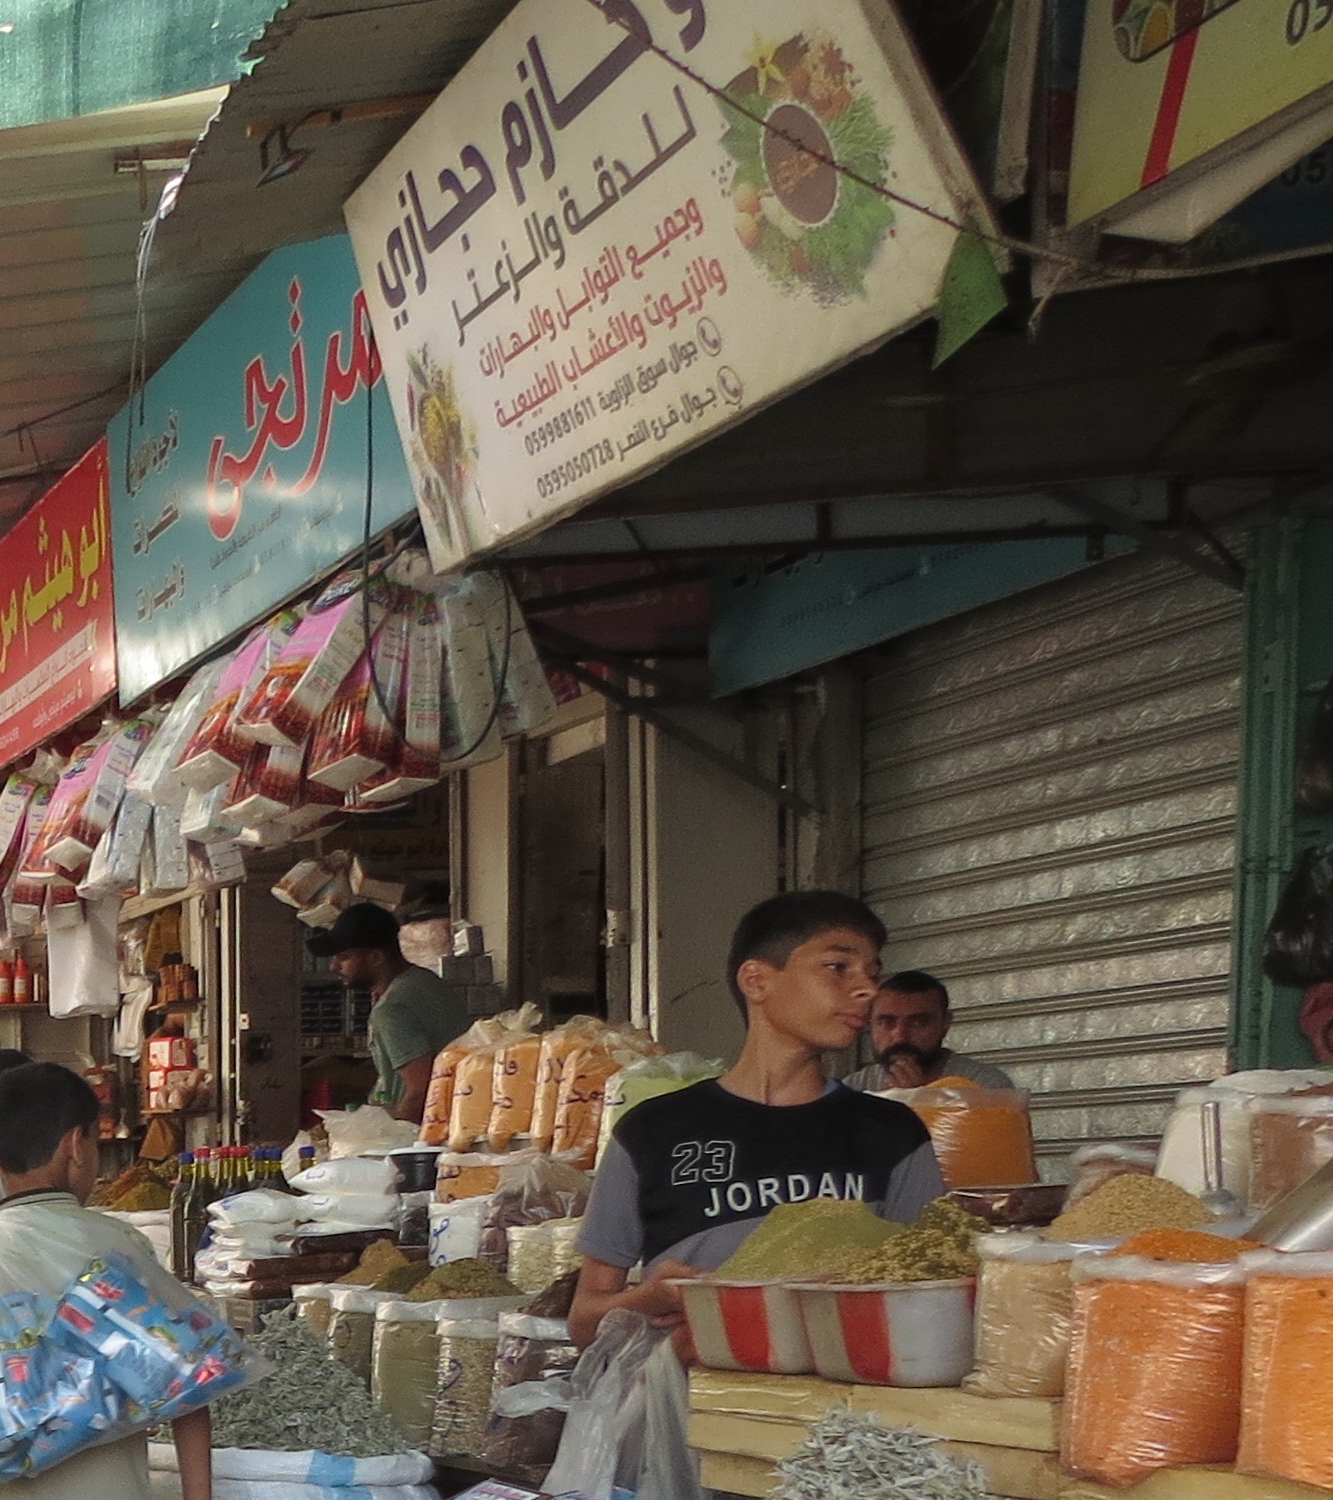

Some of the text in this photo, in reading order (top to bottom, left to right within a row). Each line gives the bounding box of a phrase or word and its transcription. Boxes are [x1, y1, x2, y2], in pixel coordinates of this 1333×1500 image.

[377, 144, 497, 332] حجازي
[448, 211, 567, 345] والزعتر
[479, 197, 704, 378] وجميع التوابل والبهارات
[643, 255, 728, 330] والزيوت
[636, 357, 668, 395] سوق
[668, 340, 698, 375] جوال
[494, 360, 563, 428] الطبيعية
[596, 372, 636, 413] الزاوية
[649, 404, 680, 442] فرع
[22, 516, 74, 656] هيثم
[671, 1139, 735, 1186] 23
[703, 1171, 865, 1218] JORDAN
